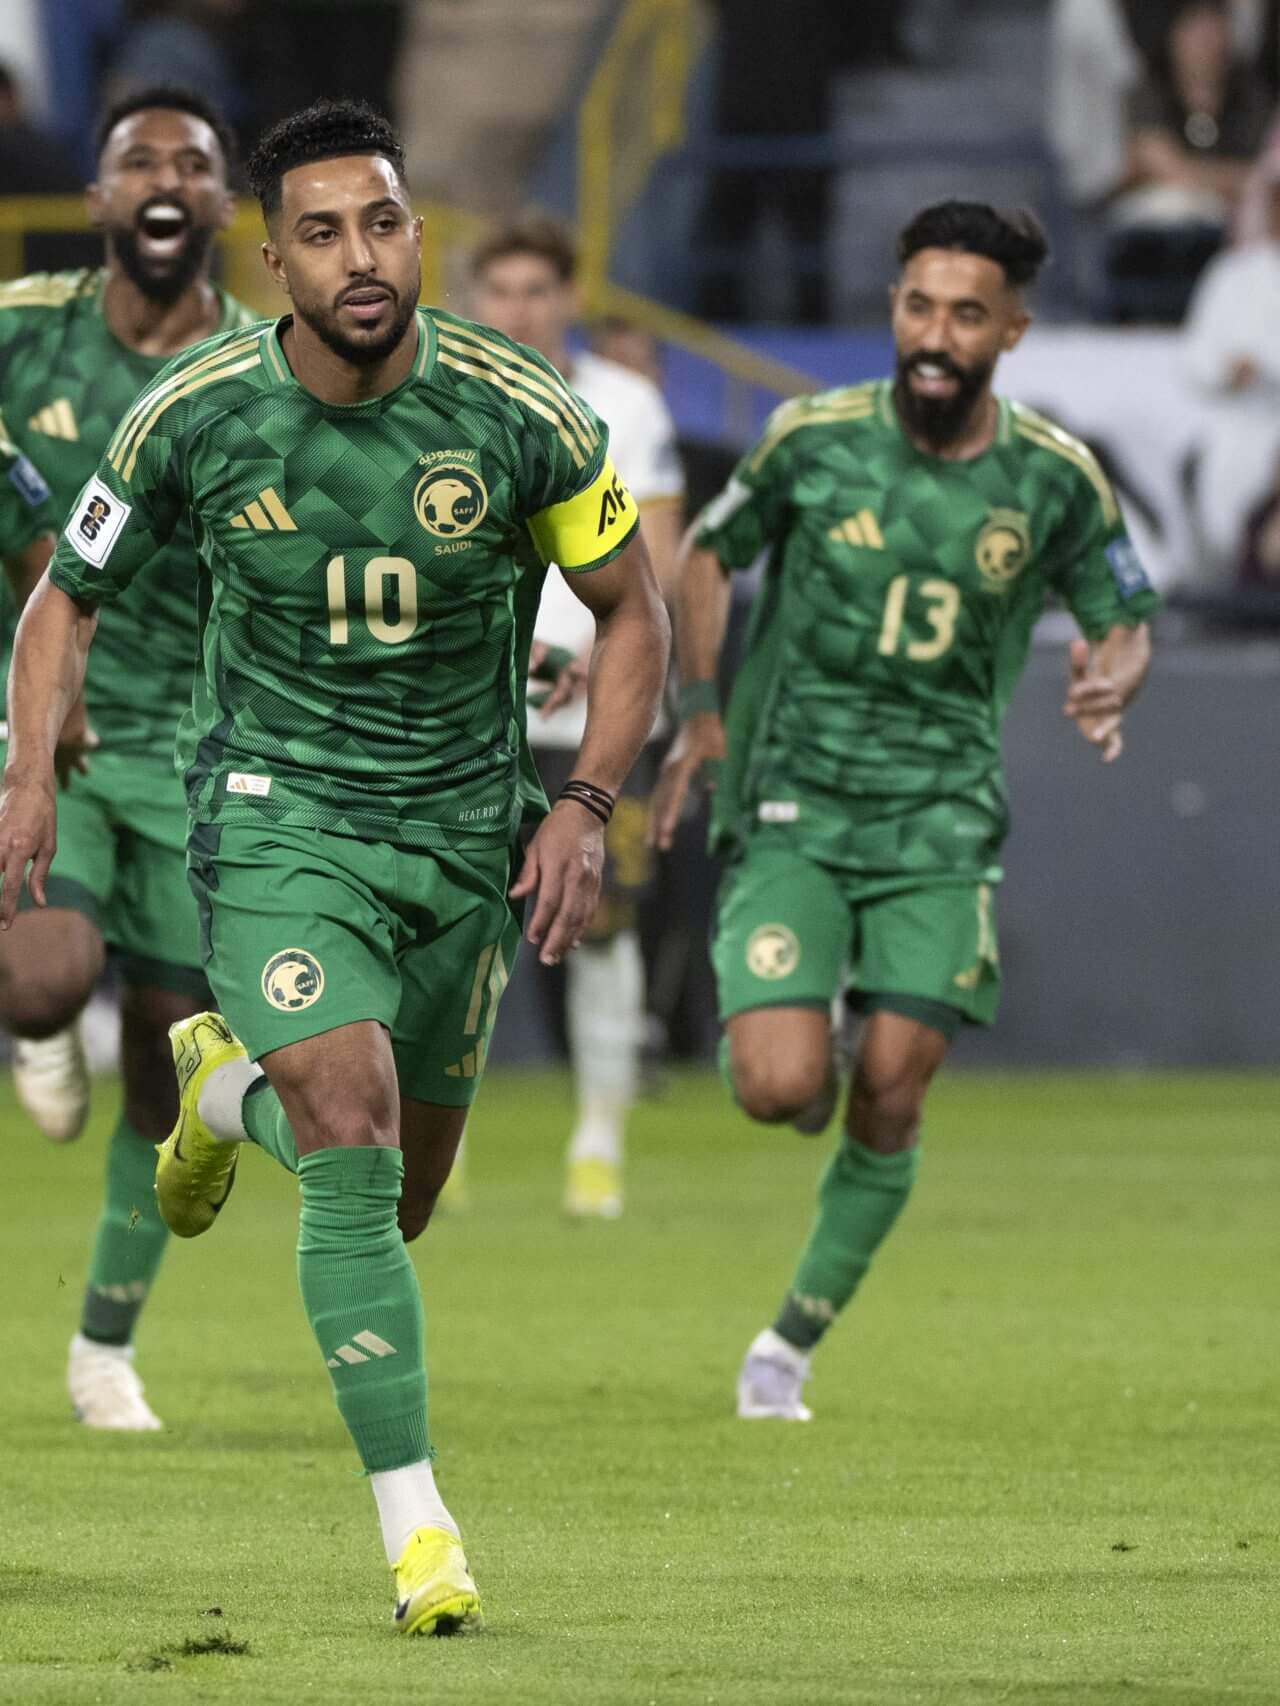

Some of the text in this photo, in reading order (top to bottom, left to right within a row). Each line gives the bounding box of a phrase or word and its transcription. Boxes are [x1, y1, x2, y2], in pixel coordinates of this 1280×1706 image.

[418, 449, 476, 465] السعودية
[453, 507, 475, 516] SAFF
[597, 472, 628, 536] AF
[434, 540, 472, 556] SAUDI
[326, 555, 418, 645] 10
[877, 575, 961, 661] 13
[458, 805, 500, 822] HEAT.RDY
